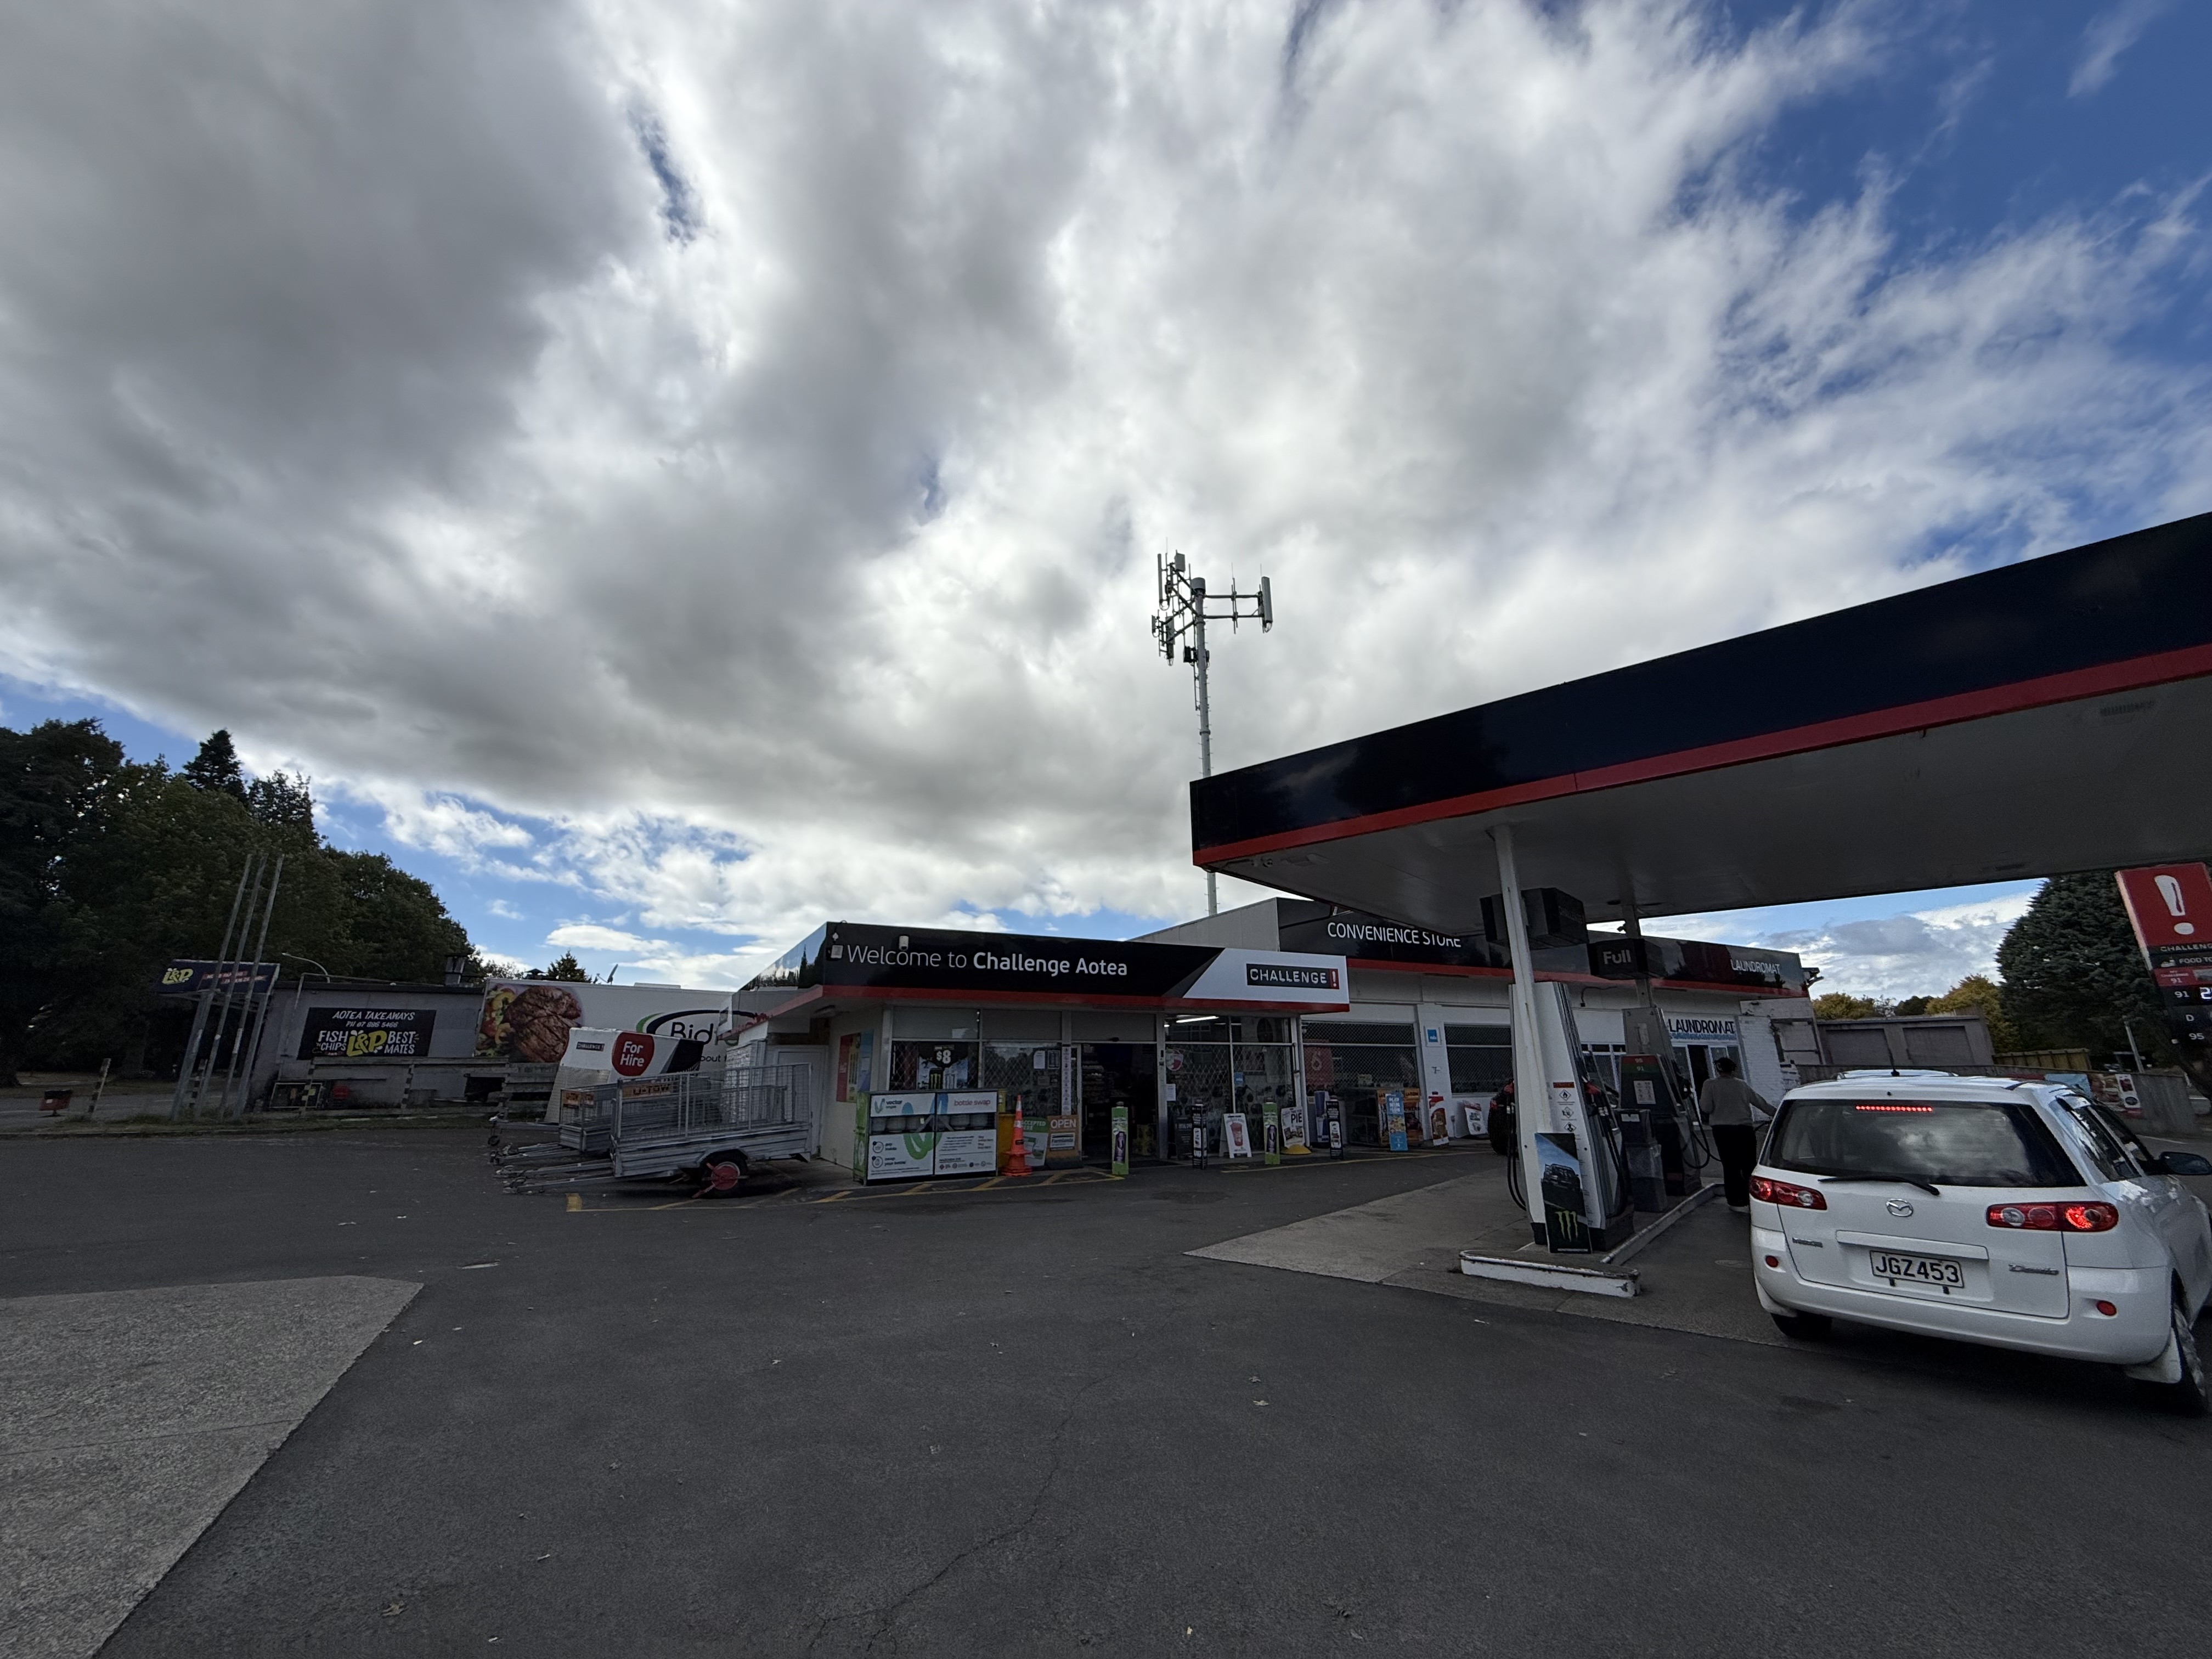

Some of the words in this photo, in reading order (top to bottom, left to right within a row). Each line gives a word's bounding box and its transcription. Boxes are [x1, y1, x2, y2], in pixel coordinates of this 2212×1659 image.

[1327, 922, 1420, 944] CONVENIENCE
[848, 944, 941, 967] Welcome
[947, 952, 967, 968] to
[973, 952, 1070, 977] Challenge
[1075, 957, 1128, 977] Aotea
[1602, 949, 1632, 964] Full
[1730, 959, 1780, 974] LAUNDROMAT
[162, 968, 194, 985] L&P
[2174, 990, 2191, 998] 91
[332, 1011, 362, 1020] AOTEA
[364, 1011, 415, 1021] TAKEAWAYS
[2185, 1014, 2195, 1022] D
[1668, 1018, 1734, 1034] LAUNDROMAT
[318, 1030, 349, 1042] FISH
[387, 1031, 416, 1045] BEST
[320, 1042, 347, 1051] CHIPS
[346, 1030, 387, 1057] L&P
[384, 1044, 415, 1054] MATES
[622, 1041, 644, 1054] For
[619, 1054, 645, 1067] Hire
[936, 1049, 951, 1064] $8
[1050, 1119, 1076, 1128] OPEN
[1291, 1113, 1302, 1124] PIE
[1875, 1256, 1959, 1283] JGZ453
